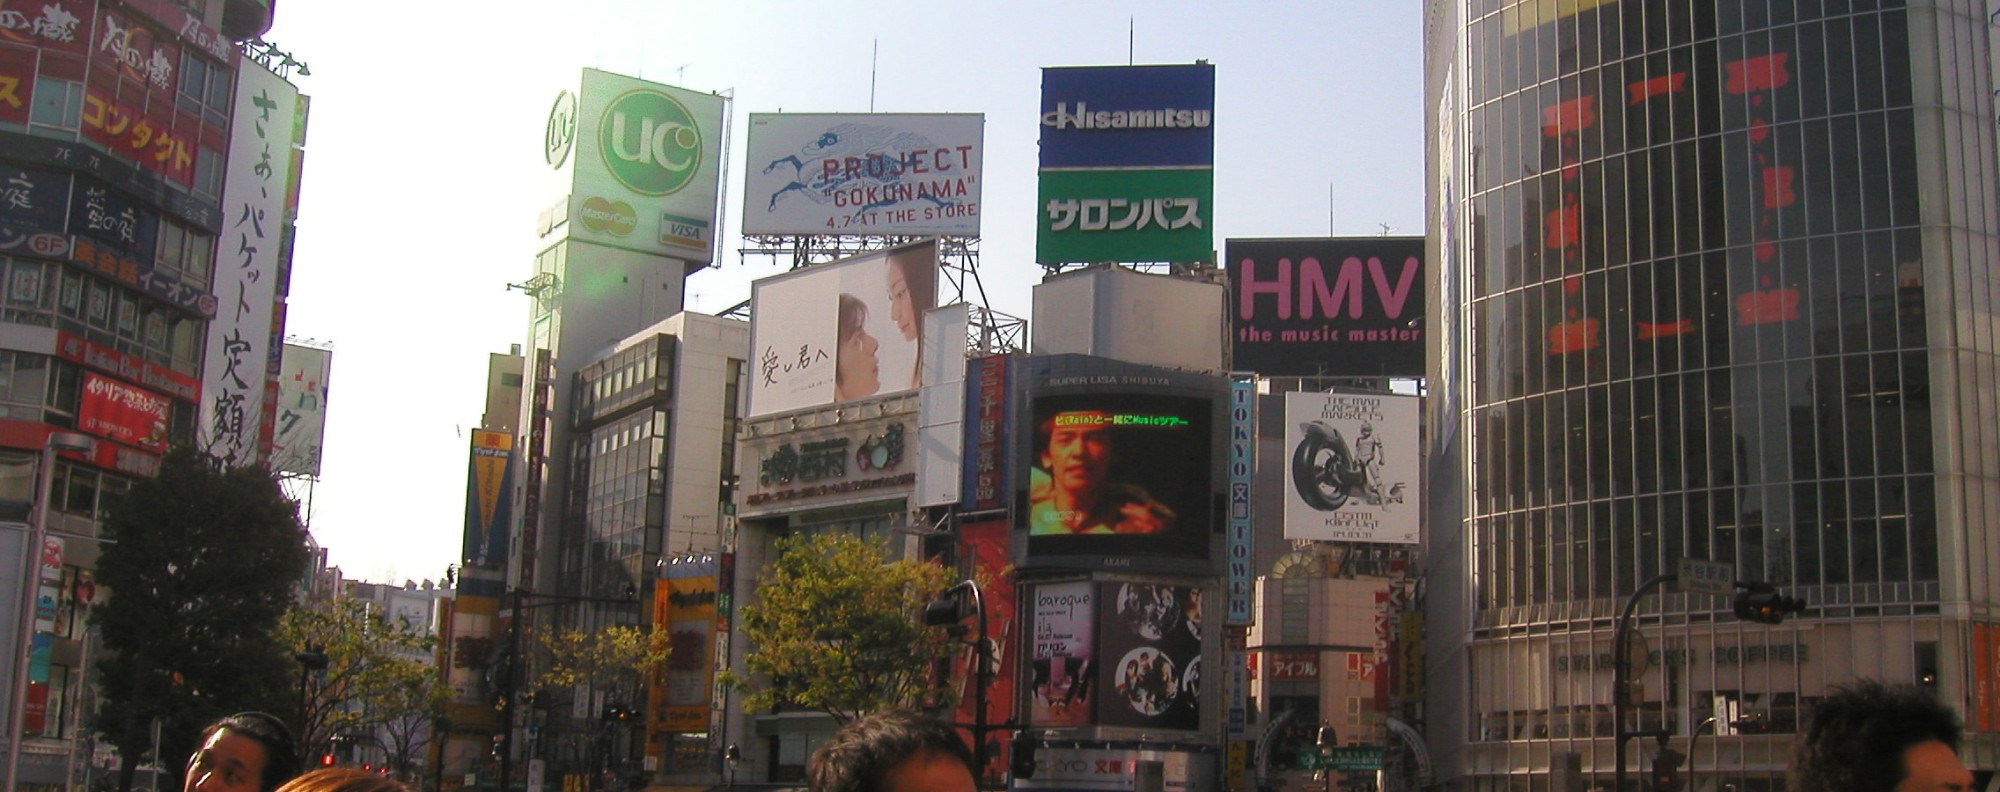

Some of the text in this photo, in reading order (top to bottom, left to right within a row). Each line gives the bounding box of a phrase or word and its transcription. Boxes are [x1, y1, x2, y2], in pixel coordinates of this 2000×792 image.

[1041, 102, 1211, 130] Hisamitsu
[82, 94, 192, 170] コンタクト
[822, 145, 973, 184] PROJECT
[823, 175, 976, 207] "GOKUNAMA"
[582, 206, 637, 226] MasterCard
[826, 203, 977, 229] 4.7 AT THE STORE
[1046, 198, 1202, 232] サロンパス
[34, 236, 64, 252] 6F
[671, 222, 701, 240] VISA
[1240, 256, 1419, 321] HMV
[1240, 326, 1420, 342] the music master
[761, 345, 829, 388] 愛し君へ
[1050, 375, 1170, 386] SUPER LISA SHIBUYA
[1321, 411, 1384, 421] MARKETS
[1233, 388, 1249, 477] TOKYO
[1231, 525, 1248, 614] TOWER
[1038, 590, 1090, 621] baroque
[1273, 661, 1317, 677] アイフル
[1558, 643, 1809, 672] STARCKS COFFEE
